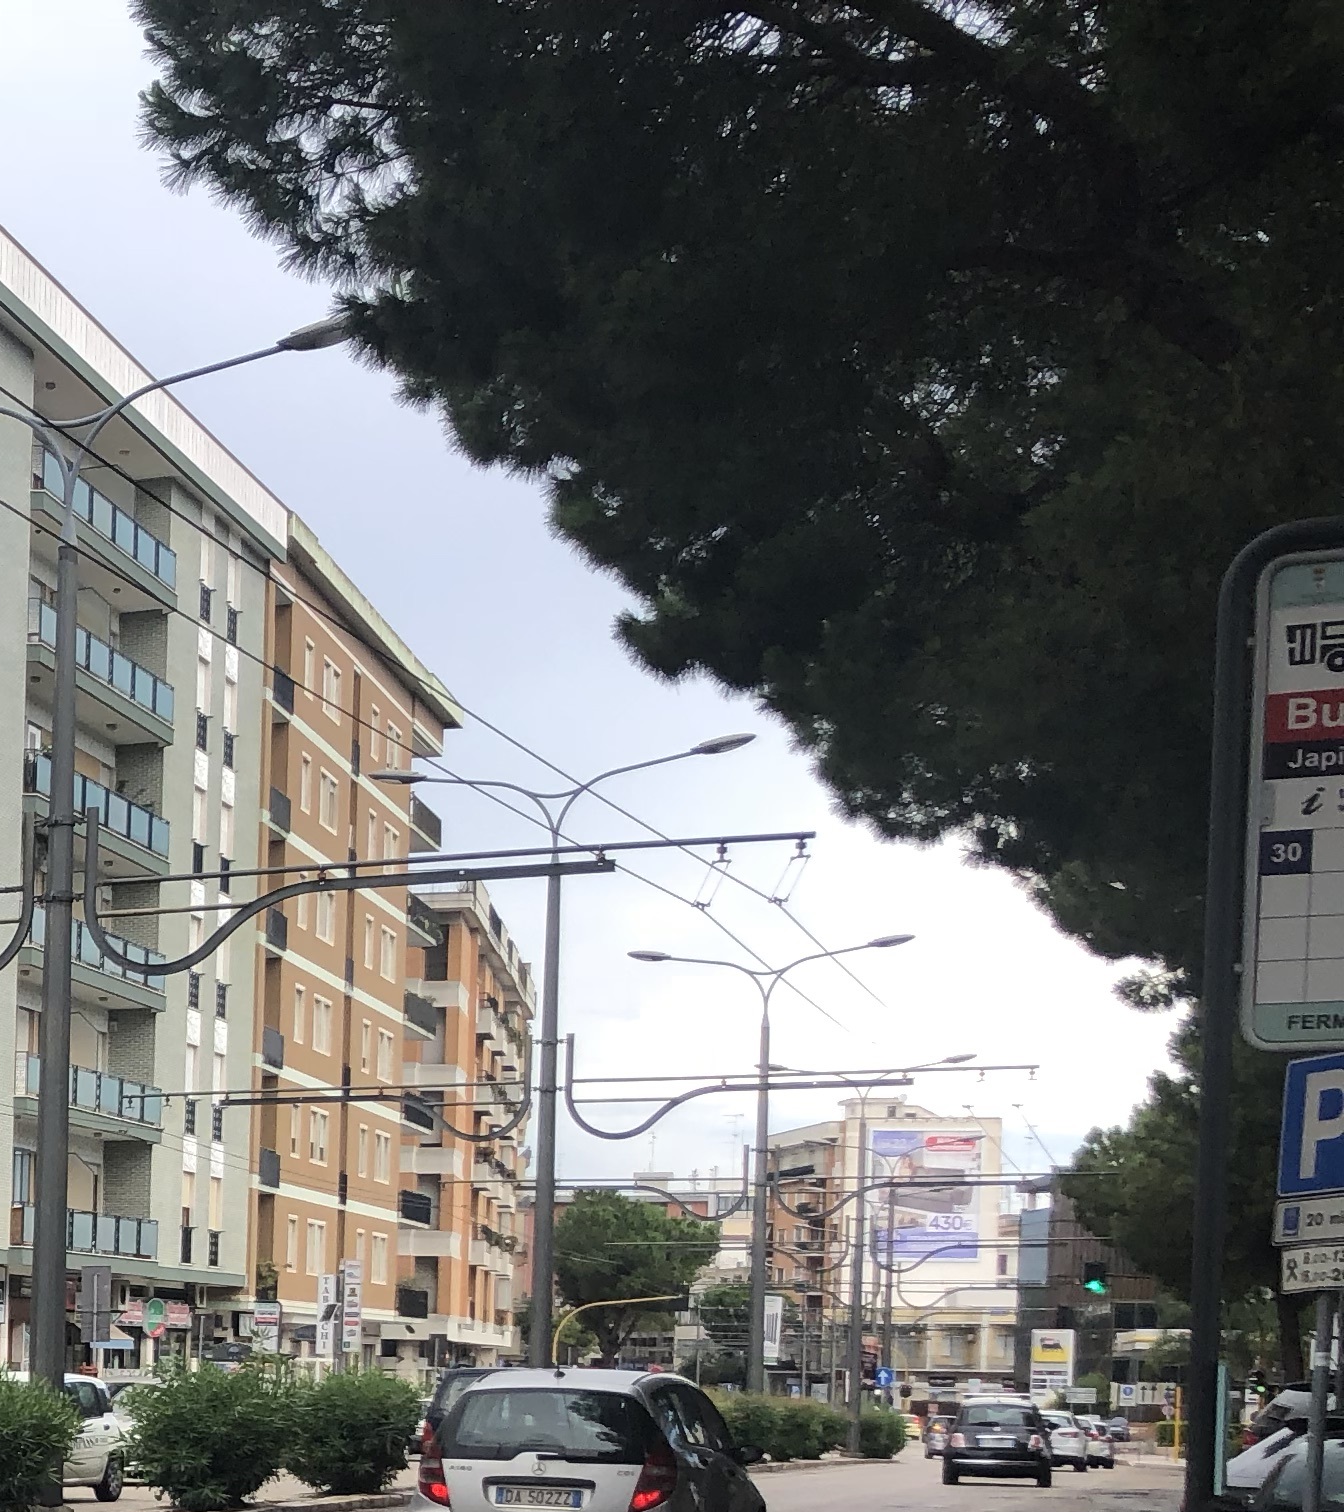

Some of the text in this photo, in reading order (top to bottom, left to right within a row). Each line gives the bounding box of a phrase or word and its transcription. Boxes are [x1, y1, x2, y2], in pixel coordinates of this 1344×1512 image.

[1270, 842, 1303, 863] 30
[1299, 1068, 1344, 1180] P
[1306, 1212, 1324, 1227] 20
[321, 1276, 330, 1349] TABCHI
[505, 1489, 572, 1505] DA 502ZZ
